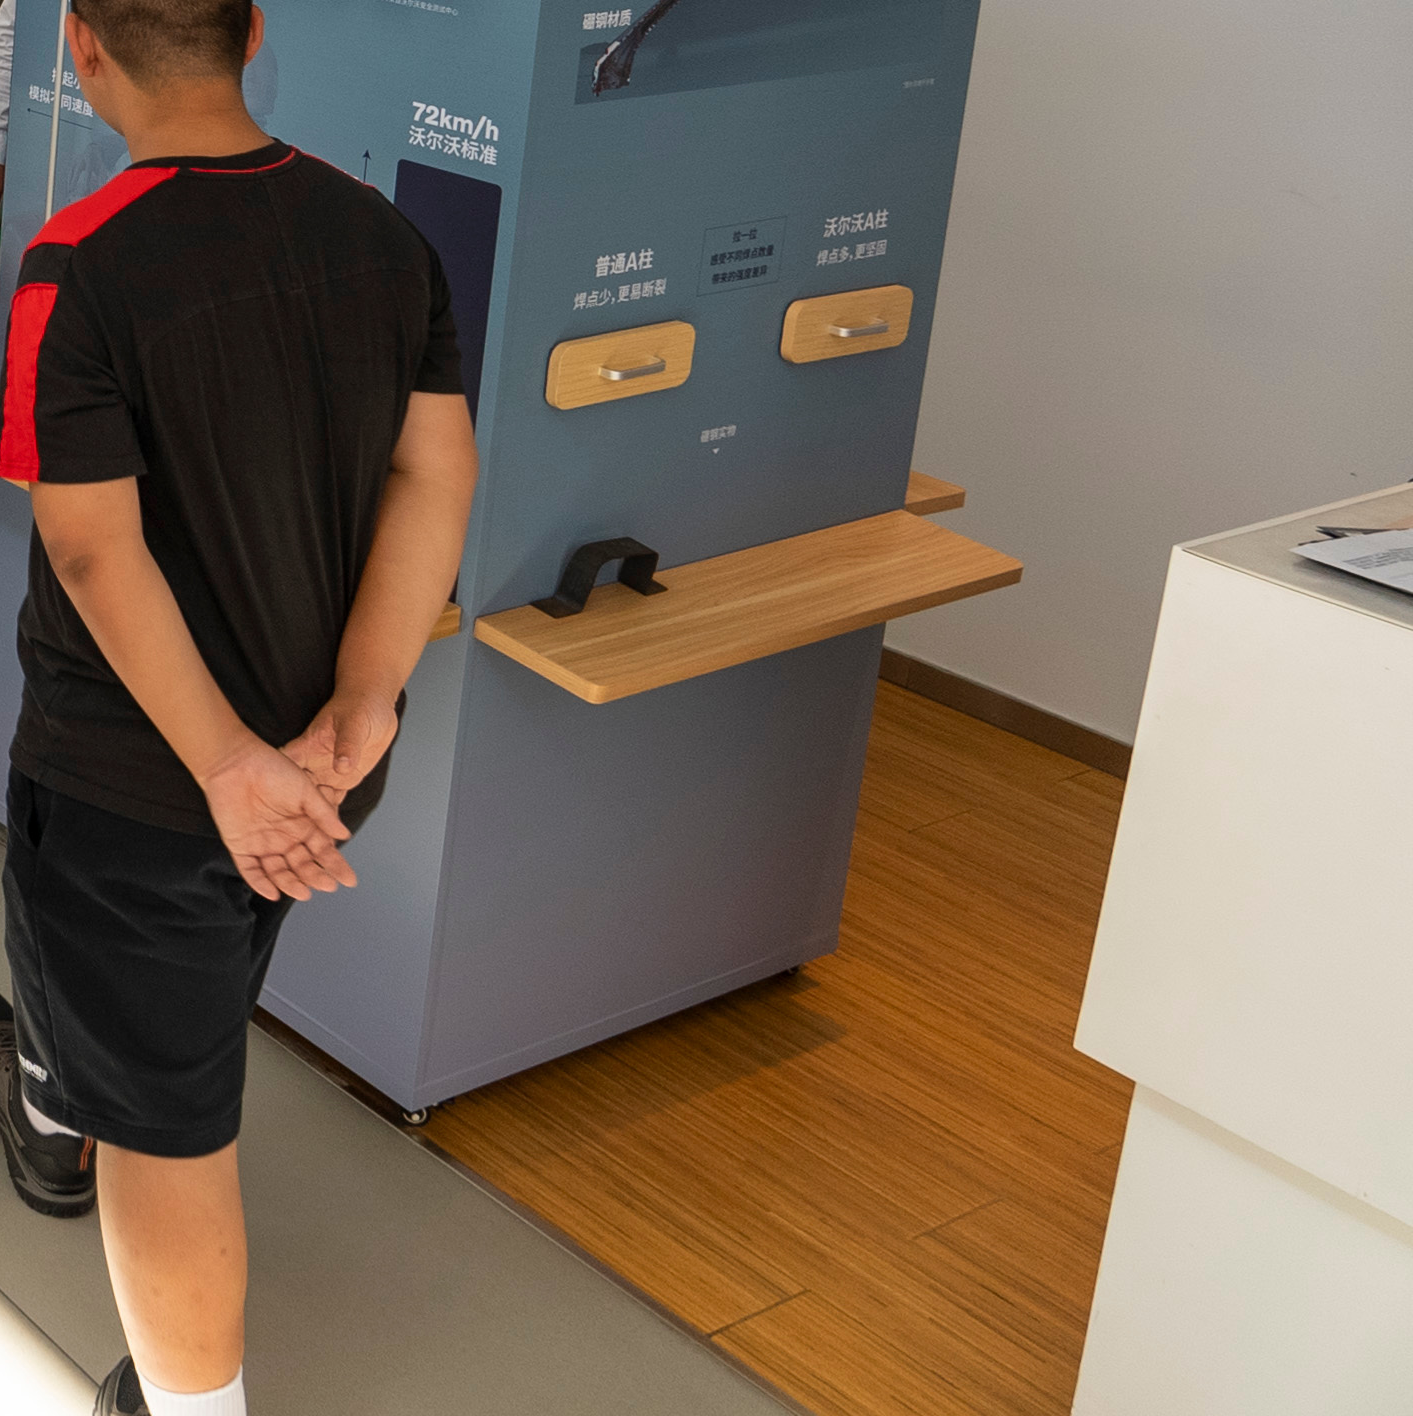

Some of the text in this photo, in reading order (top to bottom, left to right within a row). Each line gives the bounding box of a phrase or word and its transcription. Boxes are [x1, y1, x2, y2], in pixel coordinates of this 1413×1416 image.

[412, 101, 500, 141] 72km/h
[408, 125, 498, 166] 沃尔沃标准
[823, 208, 889, 238] 沃尔沃A柱
[595, 248, 654, 278] 普通A柱
